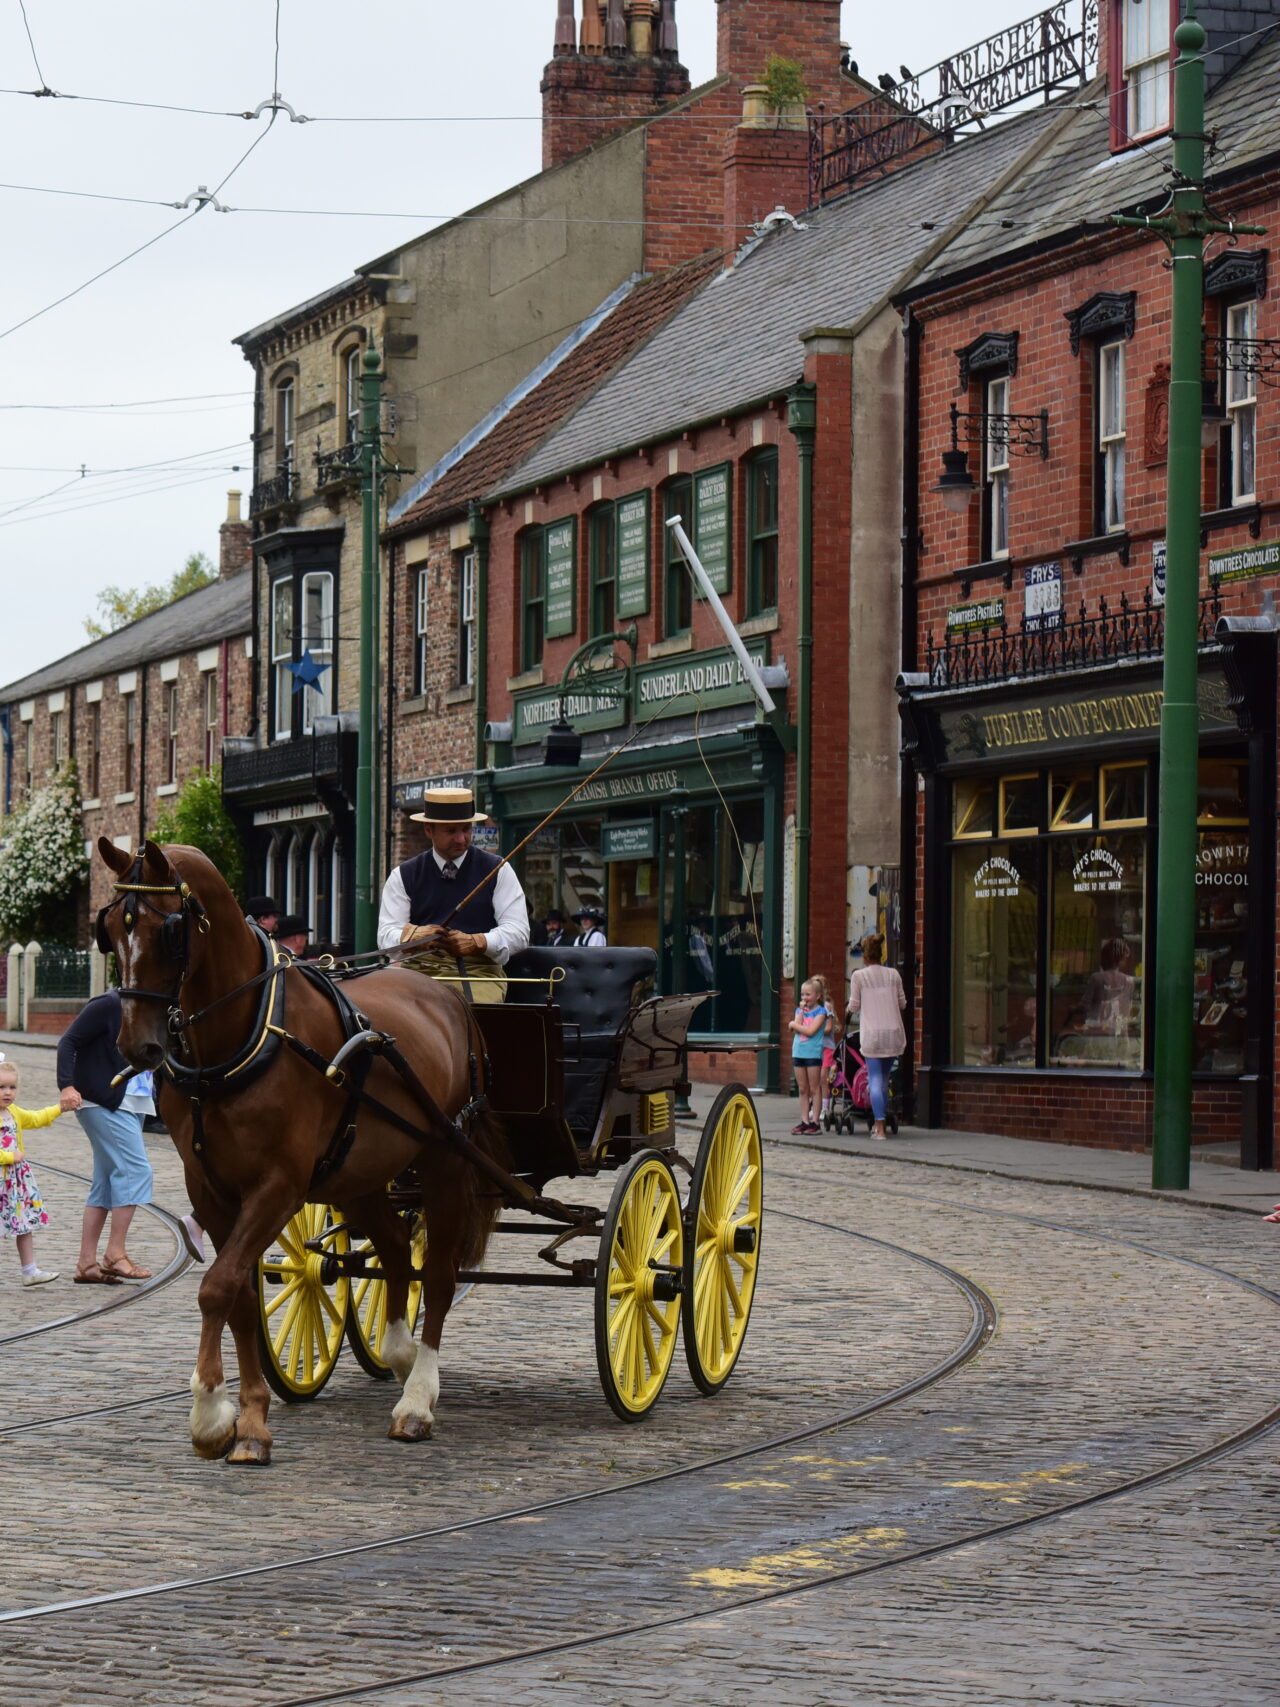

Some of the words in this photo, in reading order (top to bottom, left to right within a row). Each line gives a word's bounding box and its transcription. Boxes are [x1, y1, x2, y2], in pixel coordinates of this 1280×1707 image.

[640, 667, 704, 702] SUNDERLAND
[705, 660, 735, 690] DAILY
[567, 695, 593, 718] DAILY
[982, 708, 1048, 748] JUBILEE
[609, 775, 645, 798] BRANCH
[989, 856, 1020, 886] CHOCOLATE
[1089, 848, 1124, 880] CHOCOLATE
[1091, 882, 1097, 891] TO
[1098, 882, 1106, 891] THE
